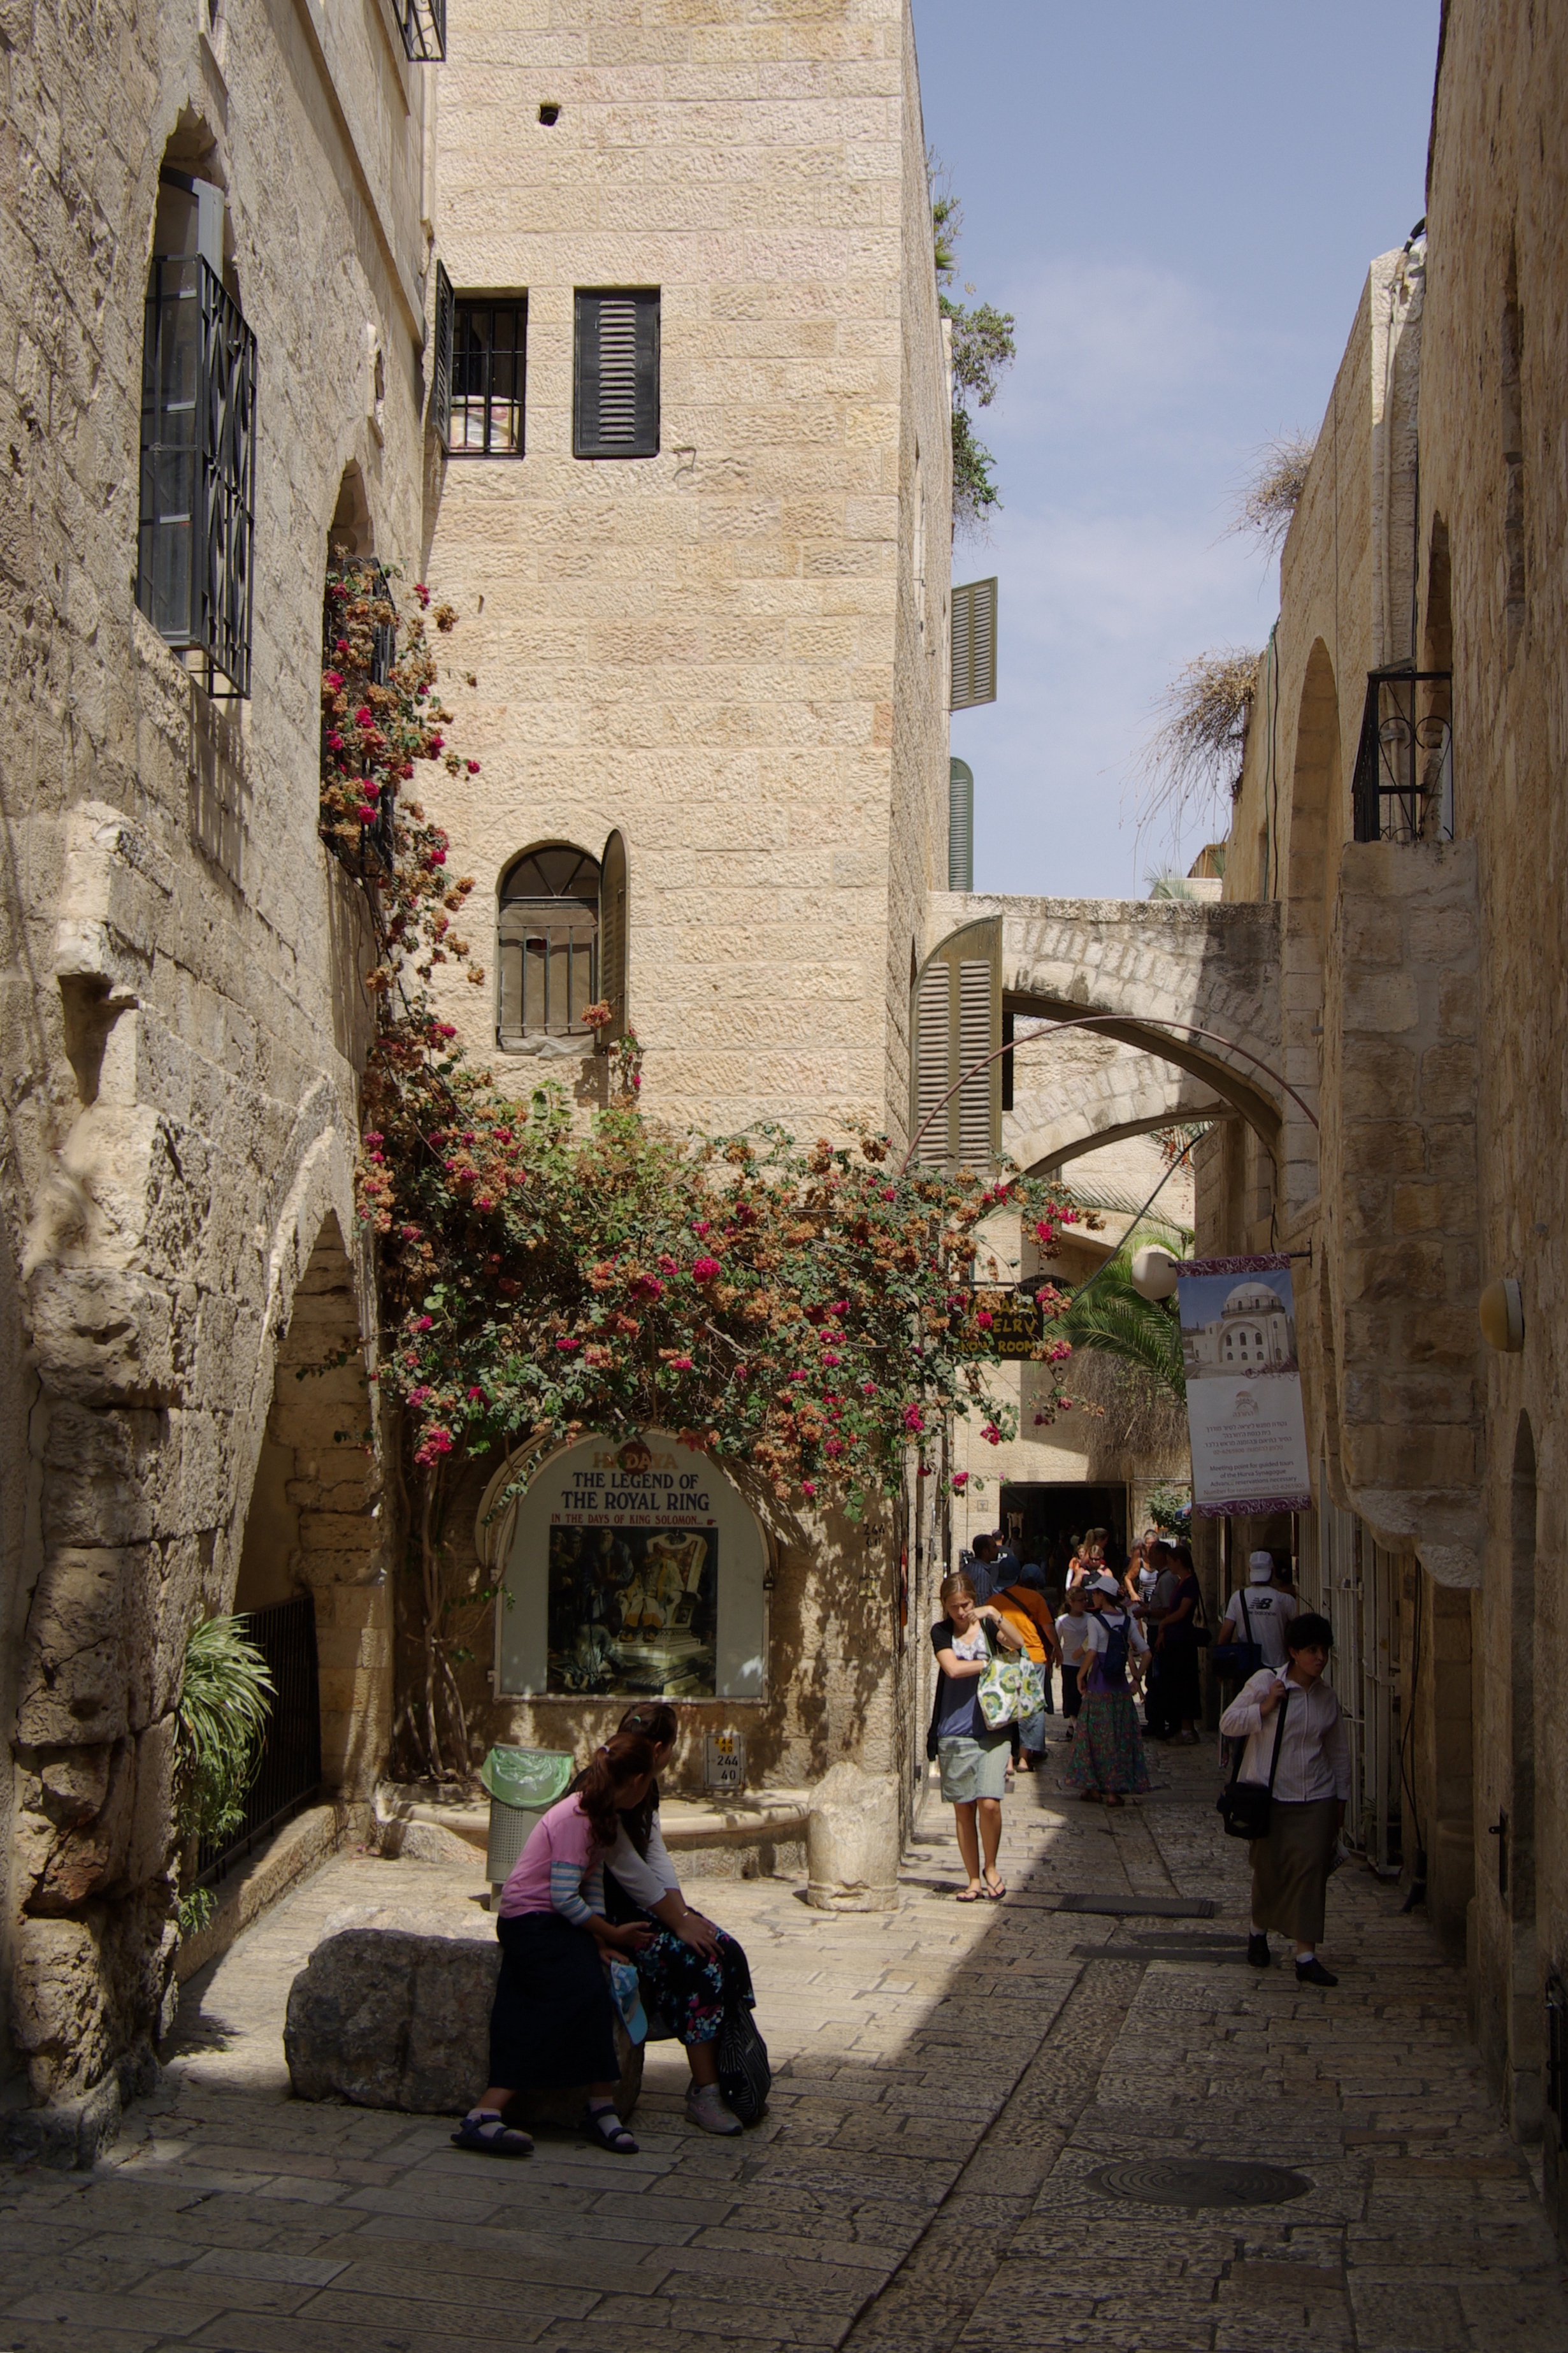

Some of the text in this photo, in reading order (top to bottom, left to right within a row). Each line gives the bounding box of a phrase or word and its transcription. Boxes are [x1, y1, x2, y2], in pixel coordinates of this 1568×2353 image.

[956, 1318, 1037, 1335] JELRY
[997, 1340, 1037, 1352] ROOM
[572, 1472, 700, 1489] THE LEGEND OF
[561, 1491, 710, 1511] THE ROYAL RING
[551, 1513, 703, 1525] IN THE DAYS OF KING SOLOMON...
[717, 1755, 738, 1766] 244
[721, 1770, 736, 1780] 40
